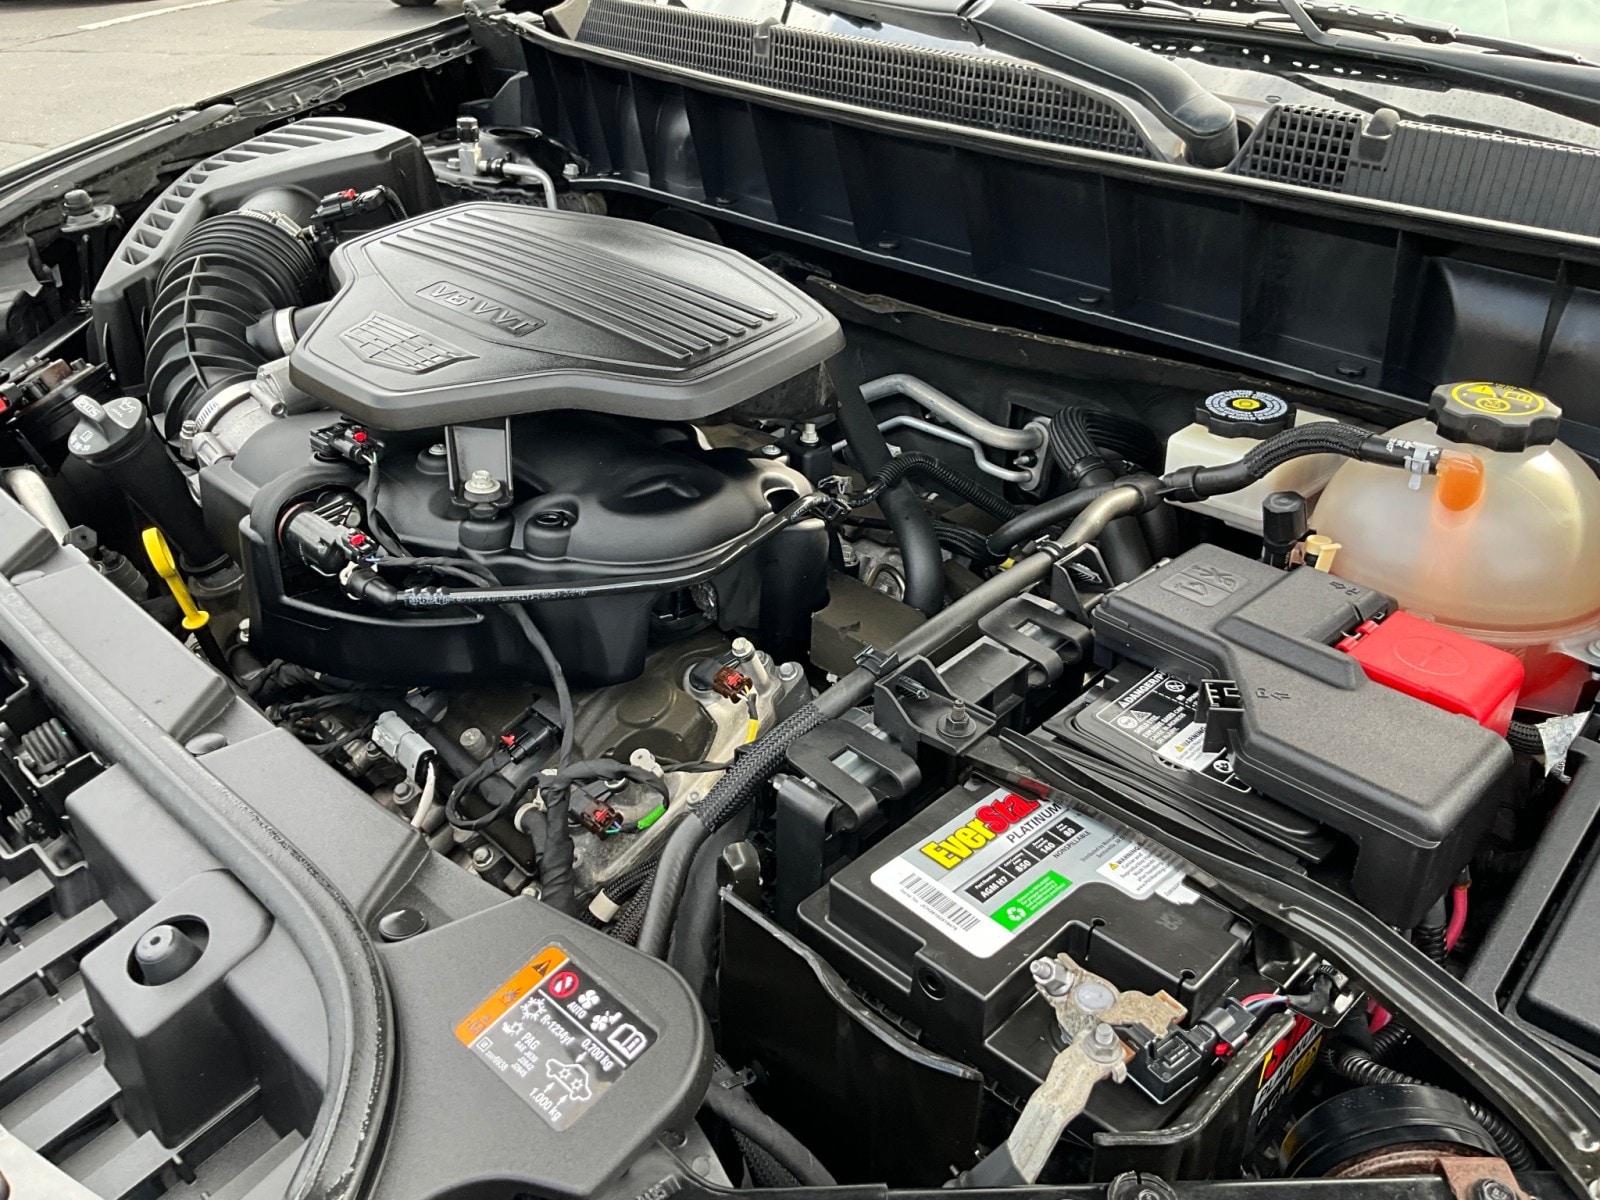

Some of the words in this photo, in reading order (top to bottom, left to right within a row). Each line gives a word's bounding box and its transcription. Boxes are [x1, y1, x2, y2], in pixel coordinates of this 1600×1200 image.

[431, 284, 474, 307] V6
[473, 299, 541, 333] VVT
[1007, 802, 1062, 844] PLATINUM
[1062, 827, 1076, 837] 80
[1038, 841, 1057, 854] 140
[1013, 858, 1032, 872] 850
[978, 882, 1000, 898] AGM
[994, 875, 1010, 886] H7
[565, 1000, 587, 1019] AUTO
[520, 1031, 541, 1050] PAG
[537, 1013, 575, 1046] R-1234yf
[579, 1037, 605, 1061] 0.700
[597, 1054, 615, 1071] kg
[527, 1086, 553, 1110] 1.000
[546, 1104, 564, 1121] kg
